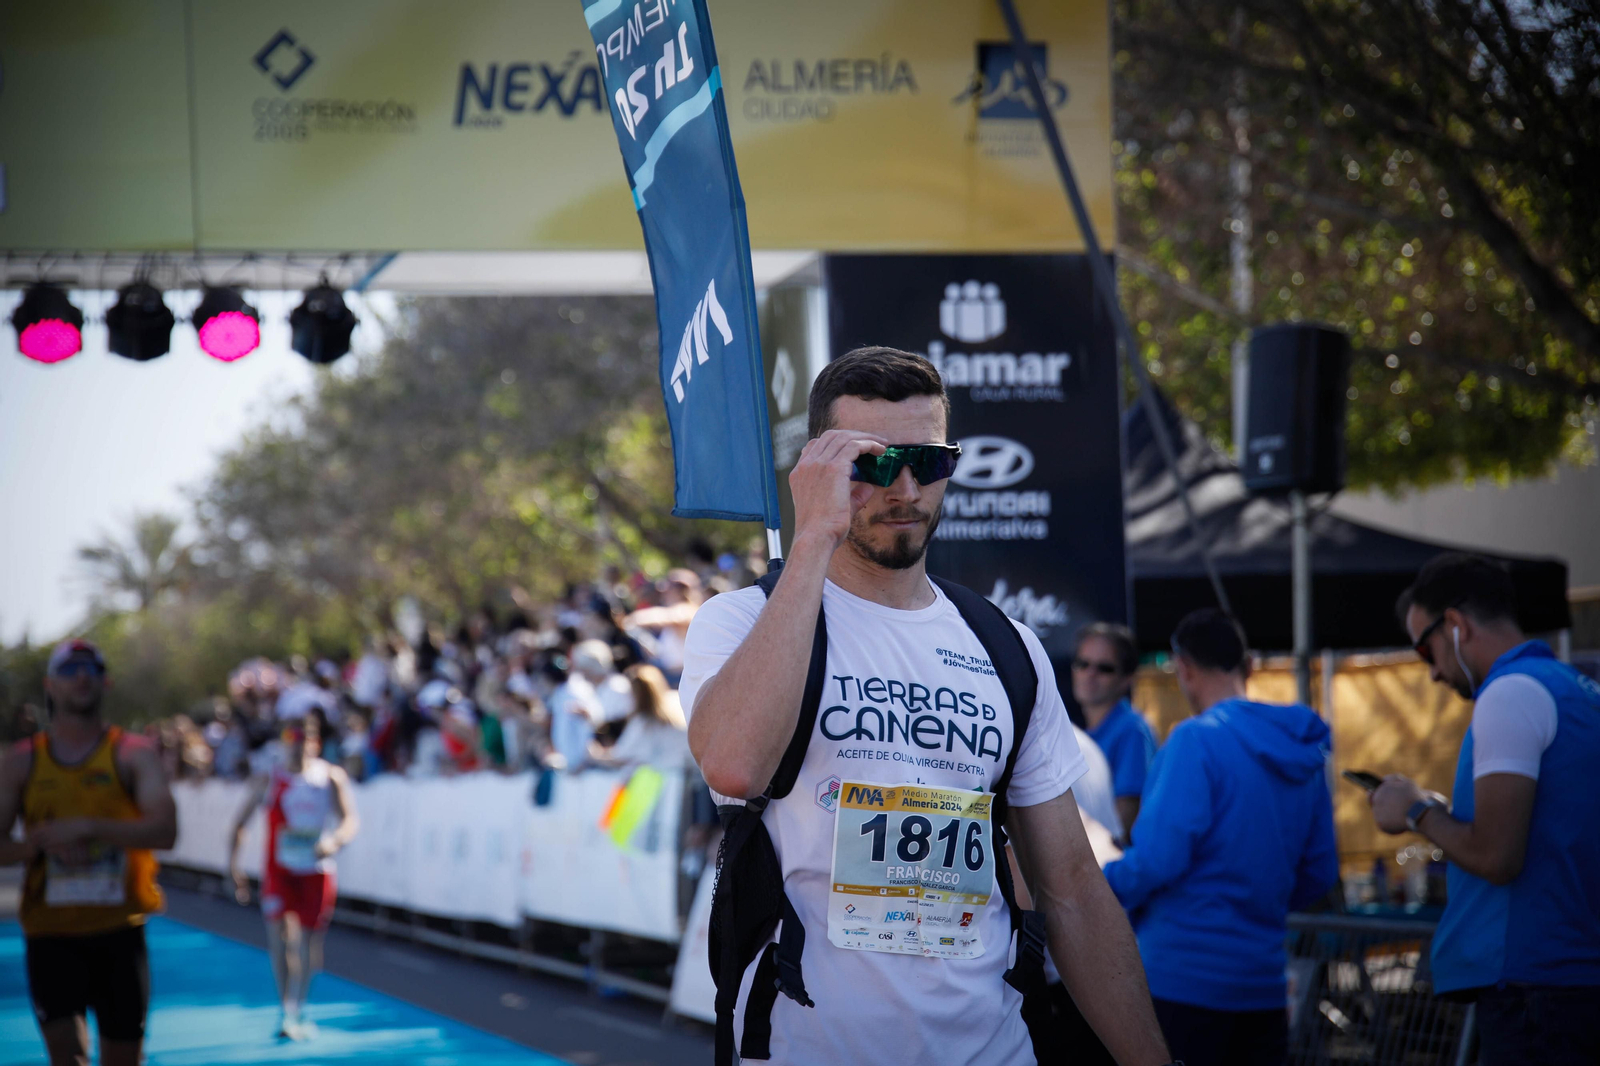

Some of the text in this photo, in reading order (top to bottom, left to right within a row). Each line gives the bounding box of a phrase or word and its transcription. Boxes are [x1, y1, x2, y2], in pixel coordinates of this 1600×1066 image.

[743, 52, 919, 95] ALMERÍA
[454, 52, 606, 126] NEXA
[743, 98, 837, 123] CIUDAD
[941, 491, 1051, 517] YUNDAI
[837, 749, 874, 759] ACEITE
[876, 751, 890, 760] DE
[916, 757, 955, 770] VIRGEN
[957, 764, 985, 777] EXTRA
[901, 798, 938, 809] Almería
[939, 800, 962, 811] 2024
[902, 789, 962, 802] Medio Maratón
[860, 813, 985, 872] 1816
[886, 865, 960, 885] FRANCISCO
